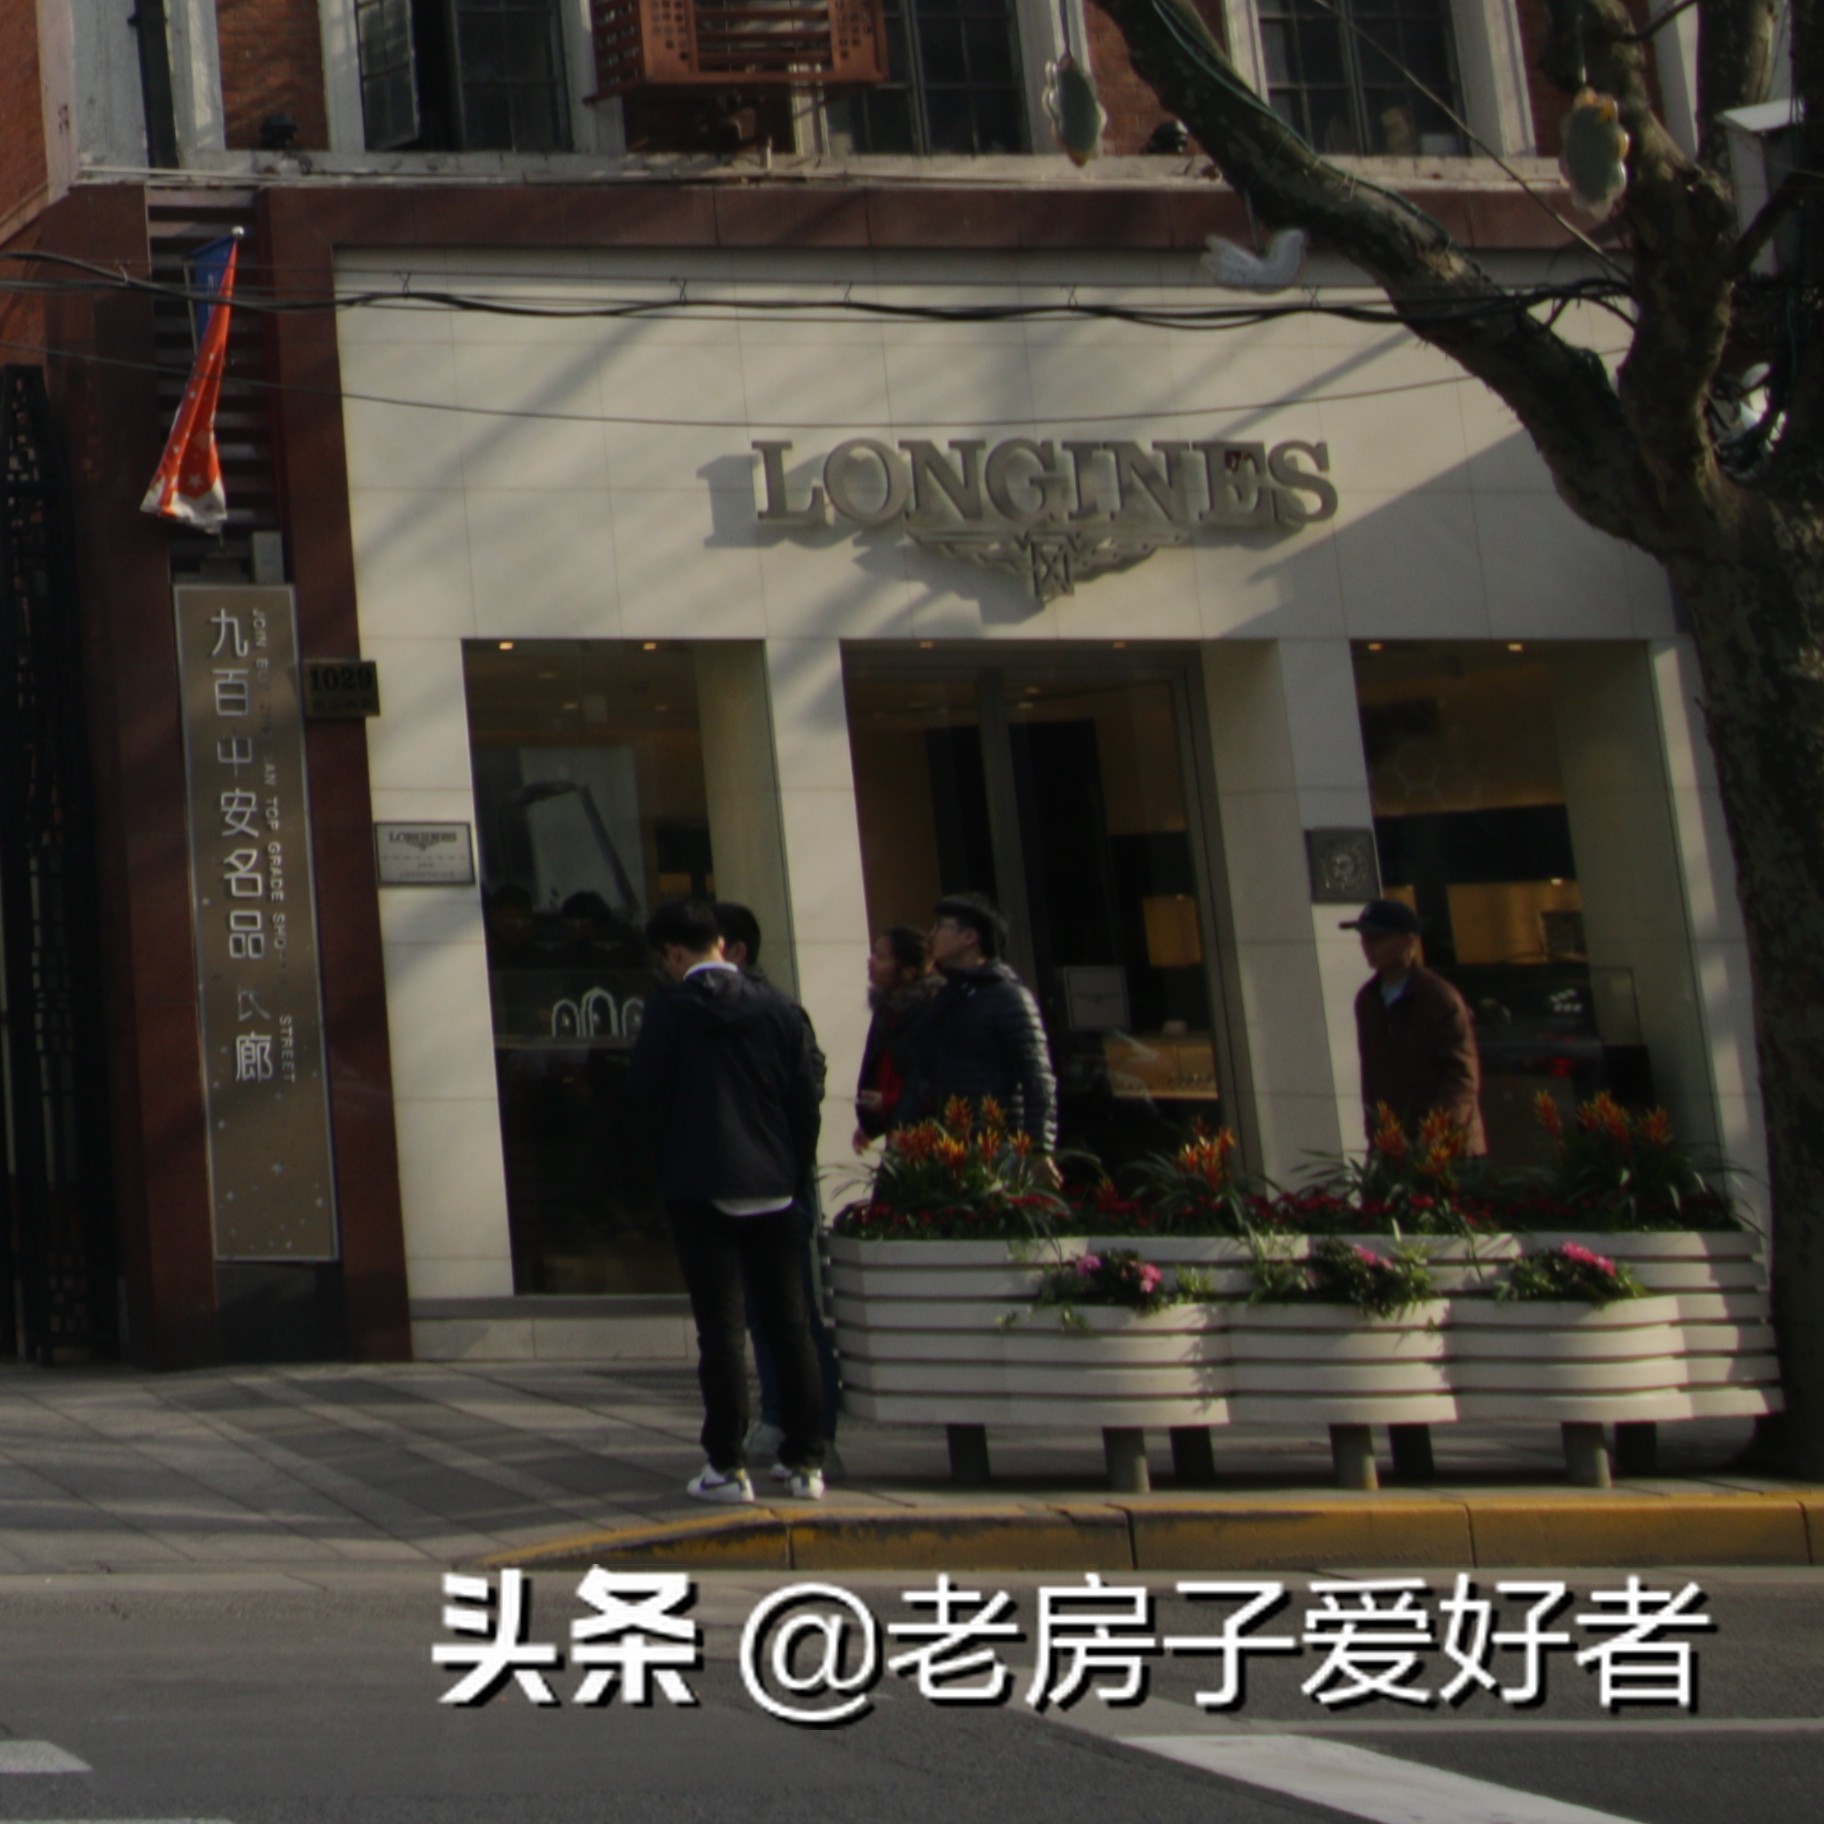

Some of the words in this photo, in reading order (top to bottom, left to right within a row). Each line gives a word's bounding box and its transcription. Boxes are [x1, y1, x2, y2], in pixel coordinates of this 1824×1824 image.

[752, 437, 1339, 524] LONGINES
[309, 666, 372, 690] 1029
[267, 841, 284, 903] GRADE
[278, 1013, 296, 1084] STREET
